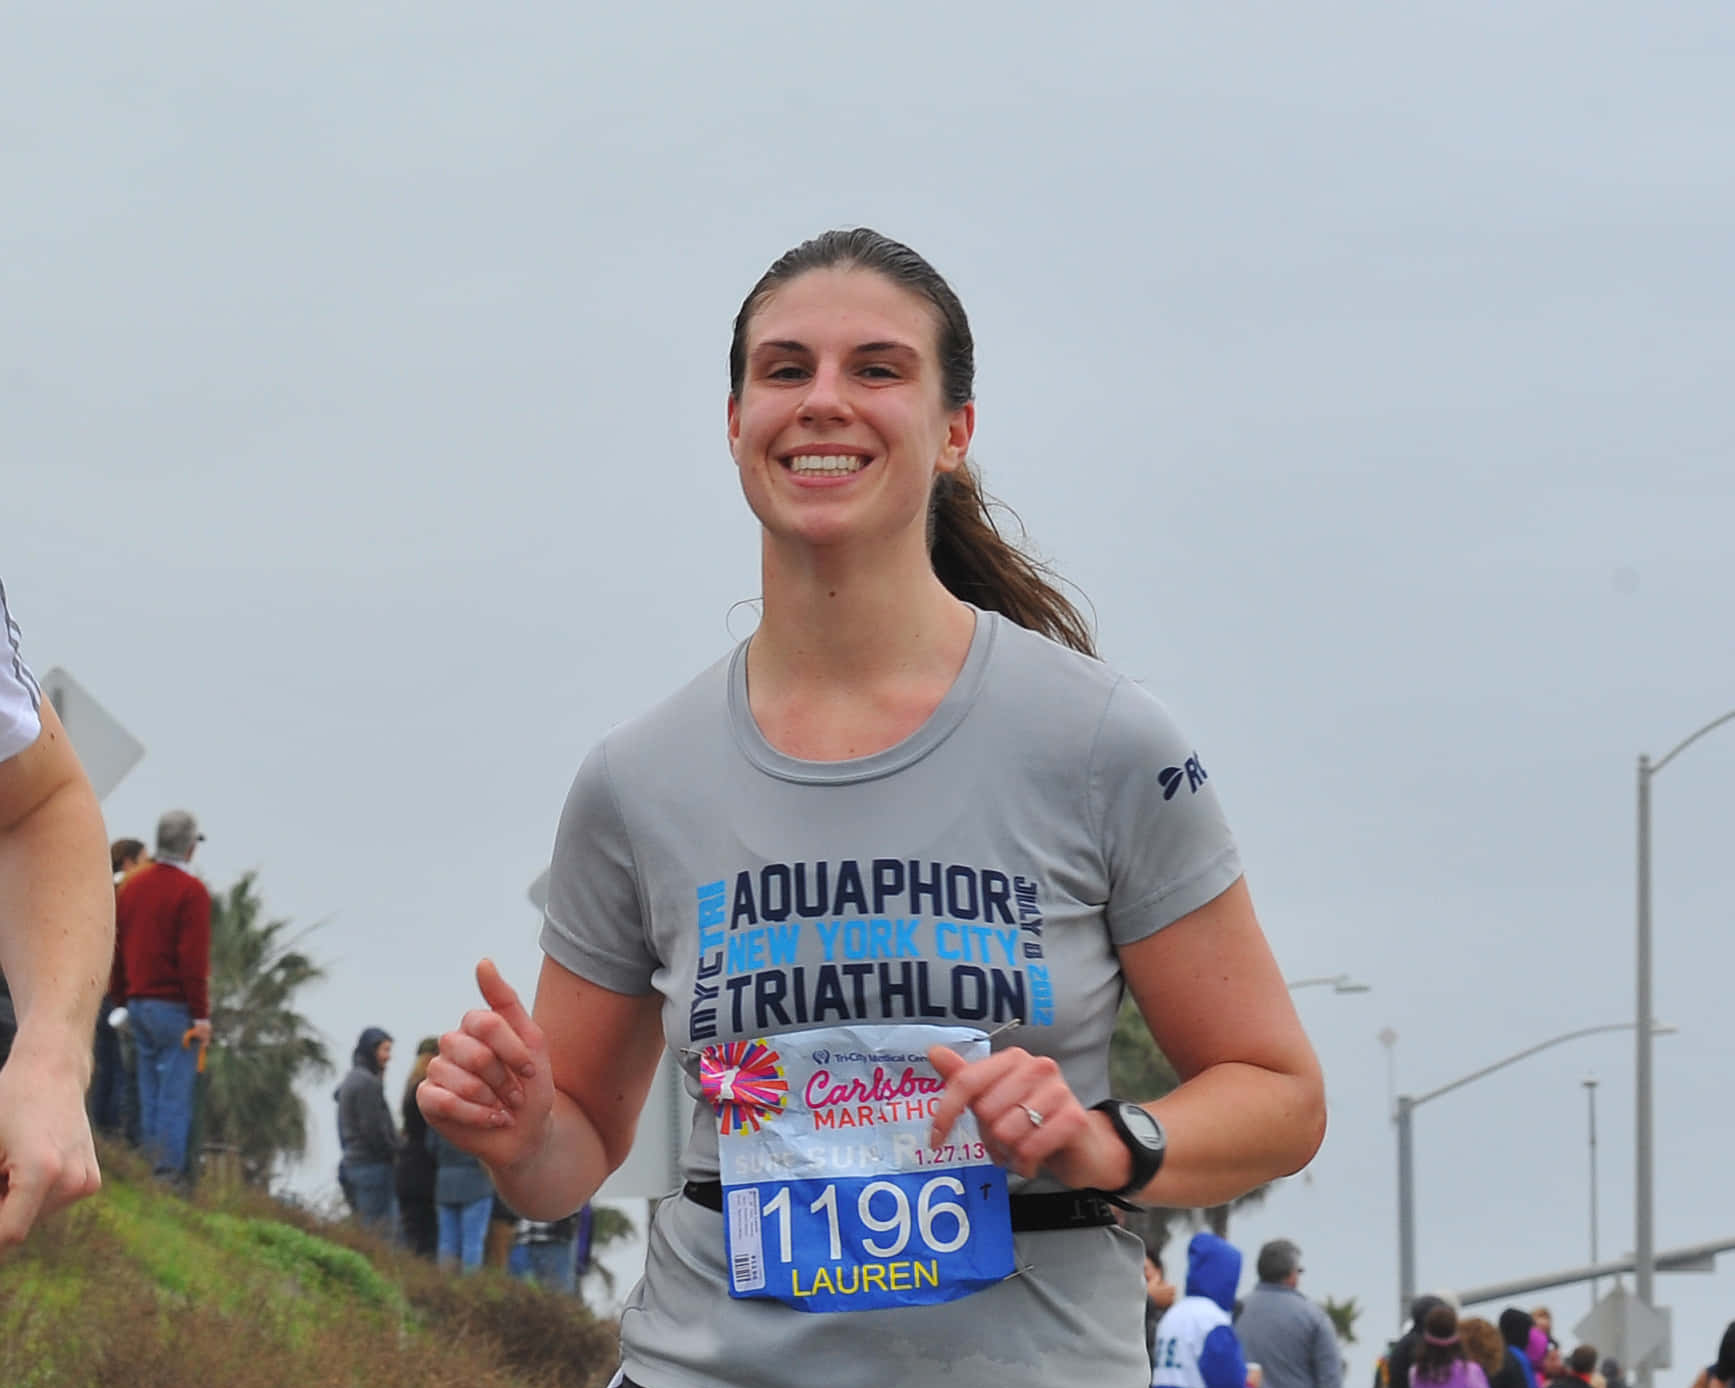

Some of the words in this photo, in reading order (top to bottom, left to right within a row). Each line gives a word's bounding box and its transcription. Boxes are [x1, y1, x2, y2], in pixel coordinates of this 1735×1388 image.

[730, 858, 1017, 931] AQUAPHOR
[1014, 876, 1043, 937] JULY
[726, 922, 801, 975] NEW
[823, 919, 922, 960] YORK
[935, 921, 1019, 966] CITY
[726, 961, 1025, 1033] TRIATHLON
[1026, 964, 1055, 1027] 2012
[805, 1067, 947, 1109] Carlsba
[915, 1142, 986, 1166] 1.27.13
[762, 1176, 972, 1264] 1196
[790, 1260, 940, 1297] LAUREN
